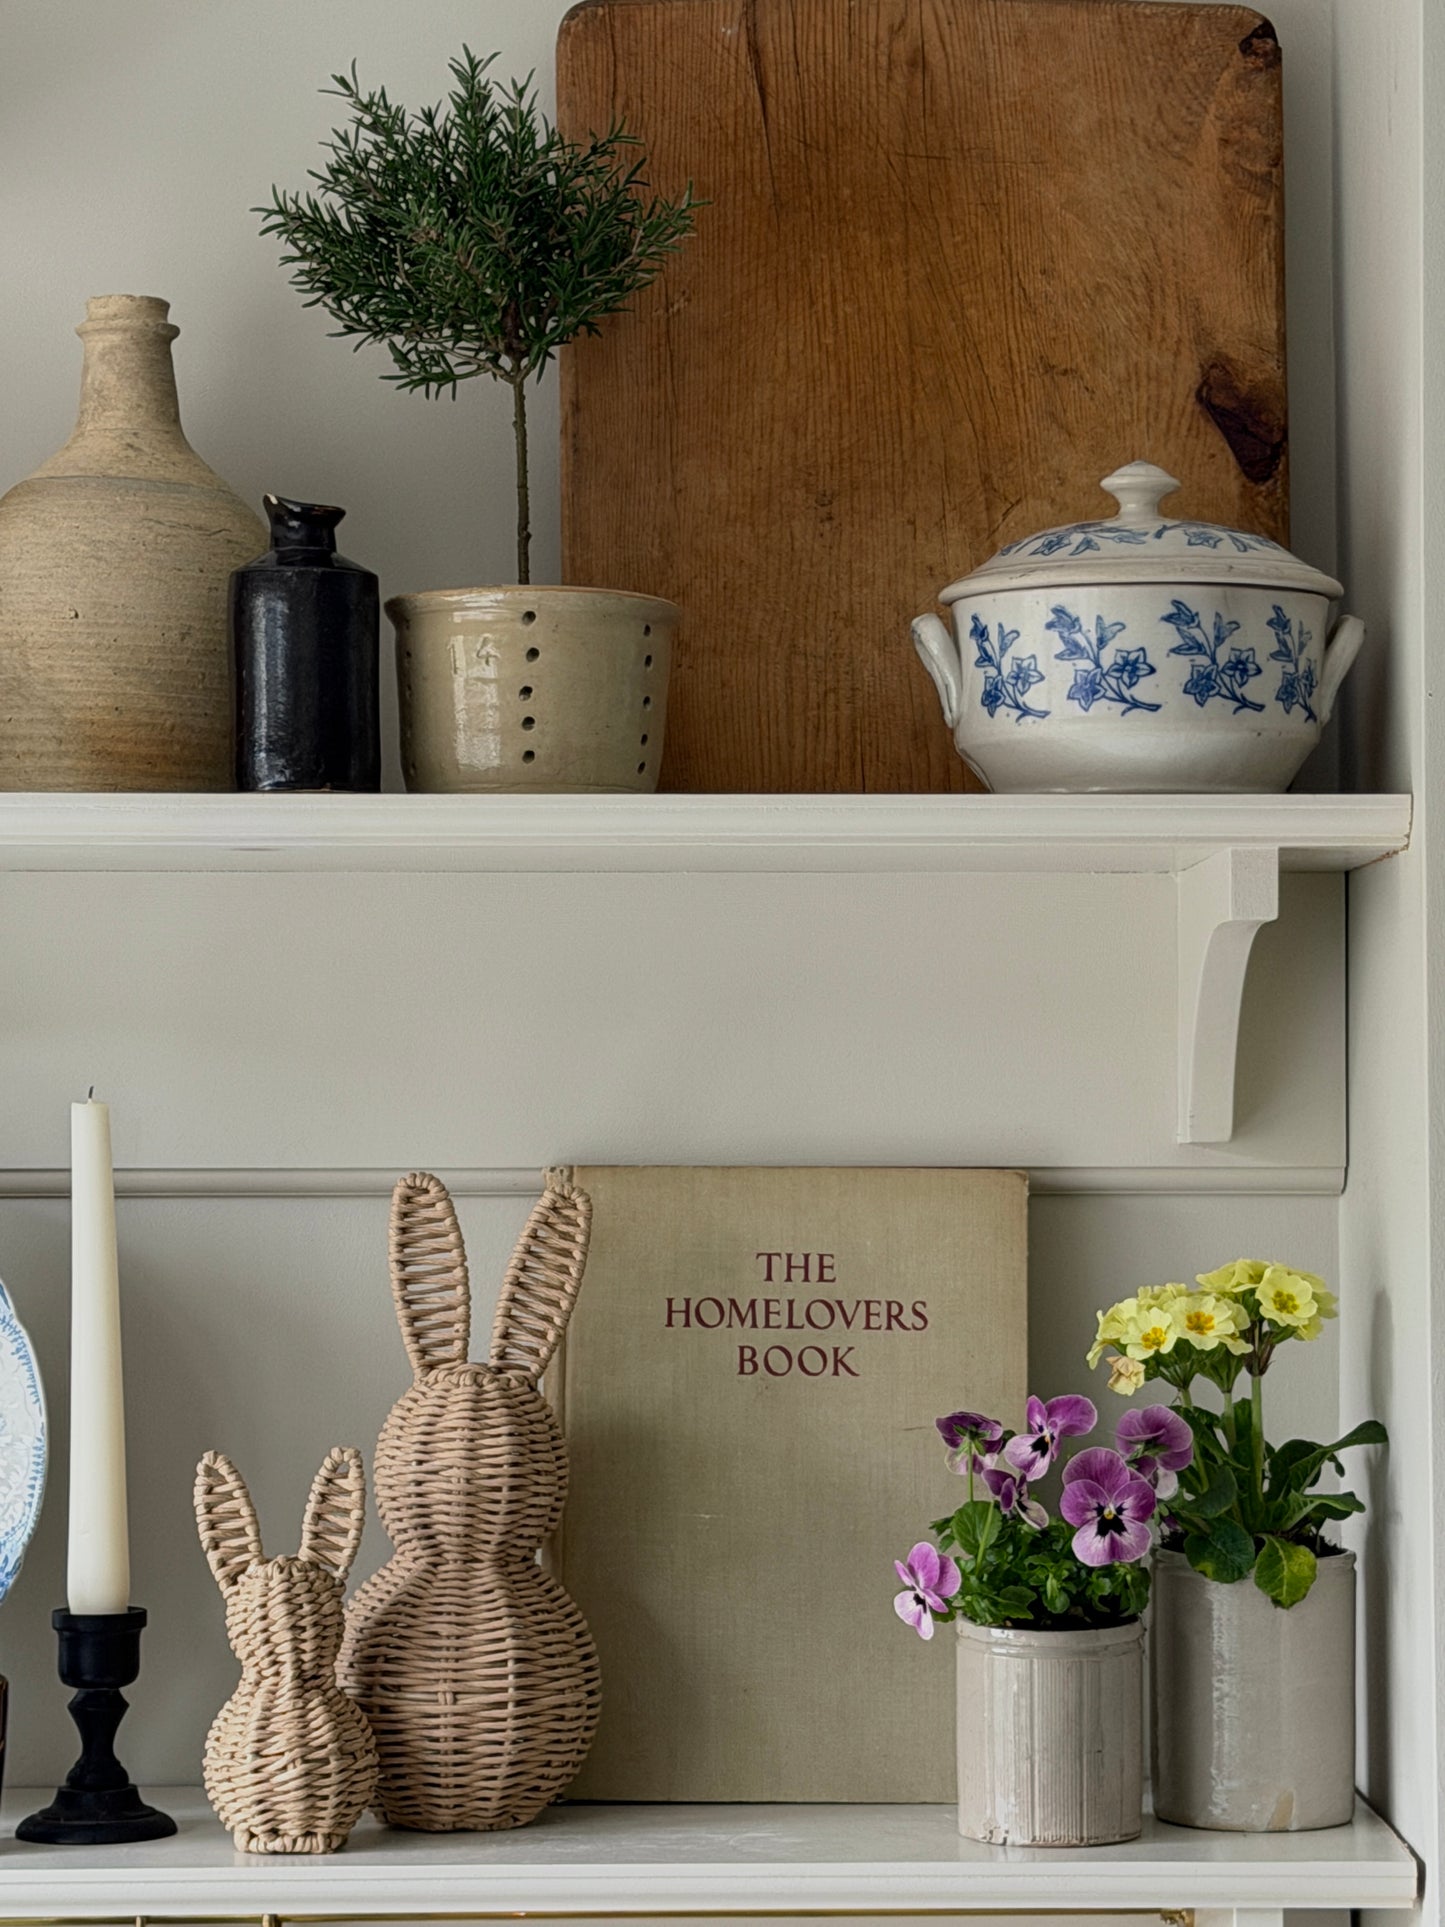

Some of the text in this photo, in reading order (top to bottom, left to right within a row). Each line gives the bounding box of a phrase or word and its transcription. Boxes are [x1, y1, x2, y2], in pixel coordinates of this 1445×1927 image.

[756, 1252, 837, 1283] THE
[664, 1297, 929, 1331] HOMELOVERS
[737, 1344, 861, 1377] BOOK
